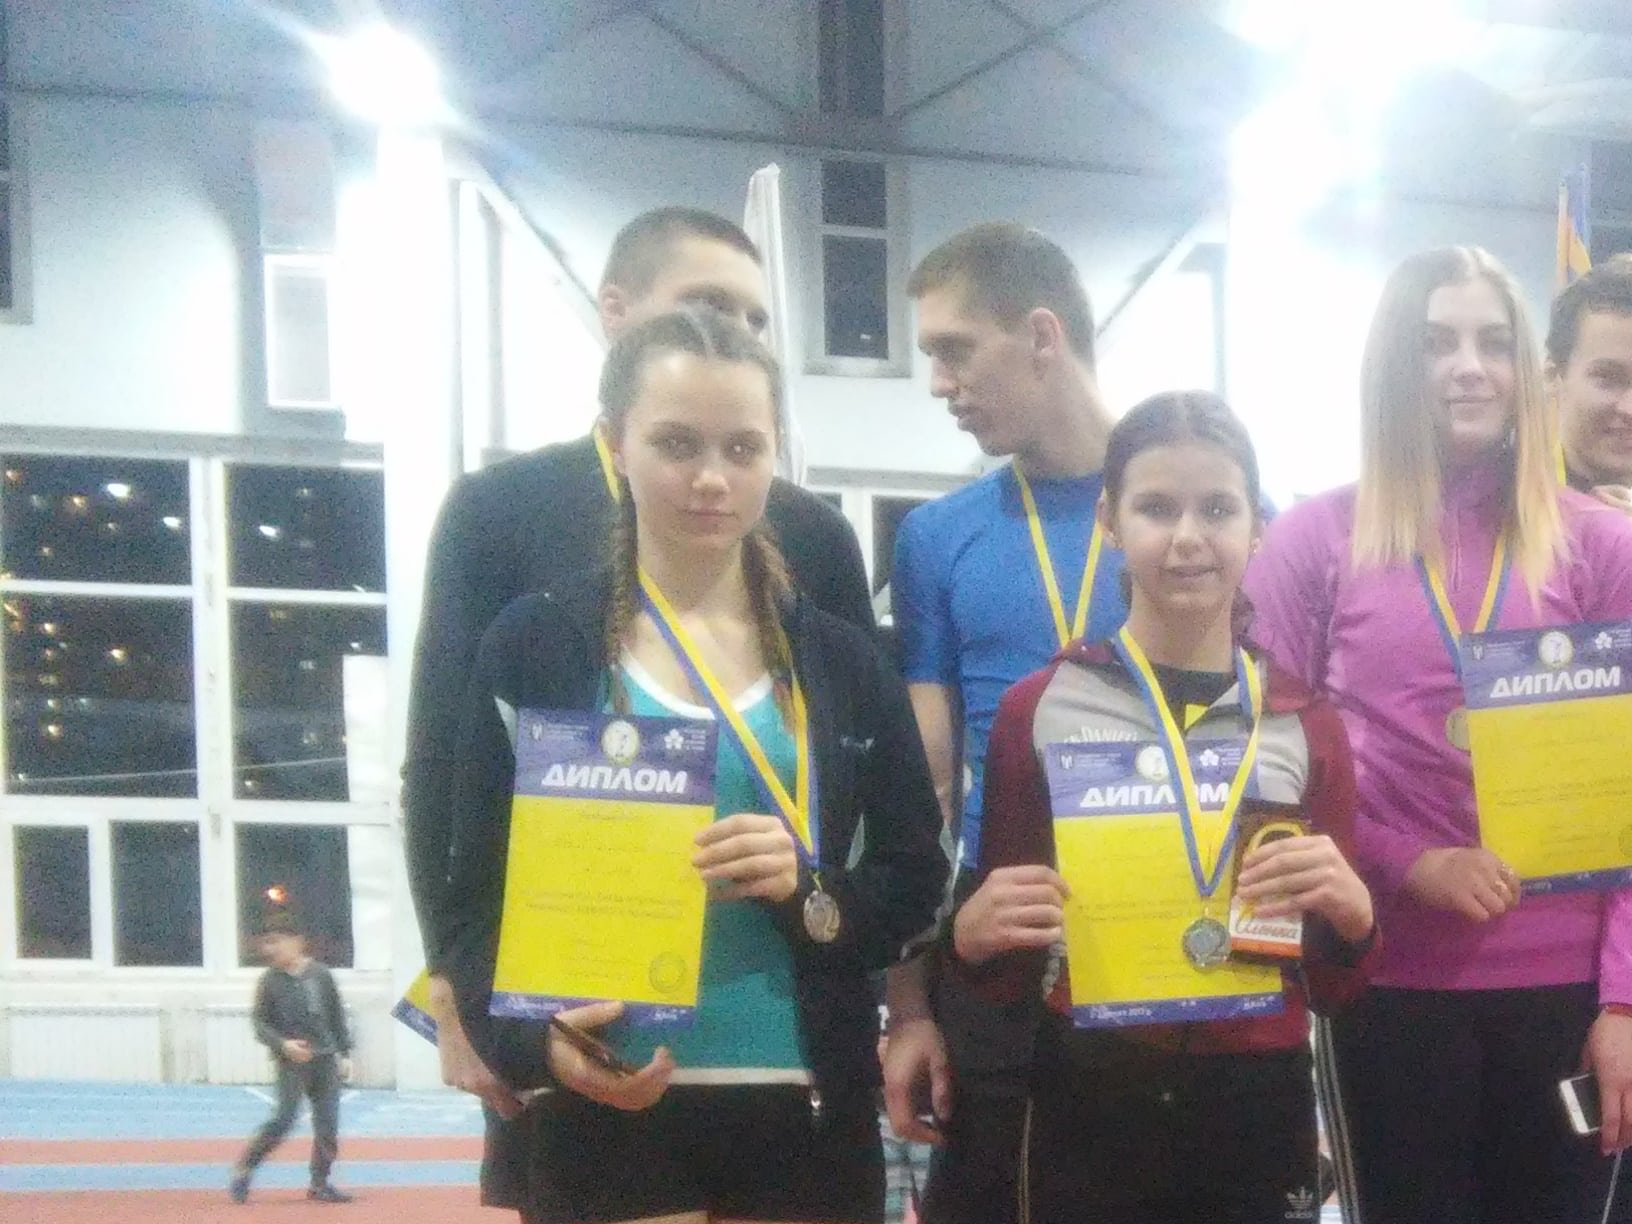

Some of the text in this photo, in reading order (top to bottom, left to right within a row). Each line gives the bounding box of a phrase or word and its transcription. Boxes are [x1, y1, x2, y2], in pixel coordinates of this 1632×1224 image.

[1489, 666, 1621, 698] ДИПЛОМ
[541, 763, 688, 794] ДИПЛОМ
[1080, 782, 1231, 808] ДИПЛМ
